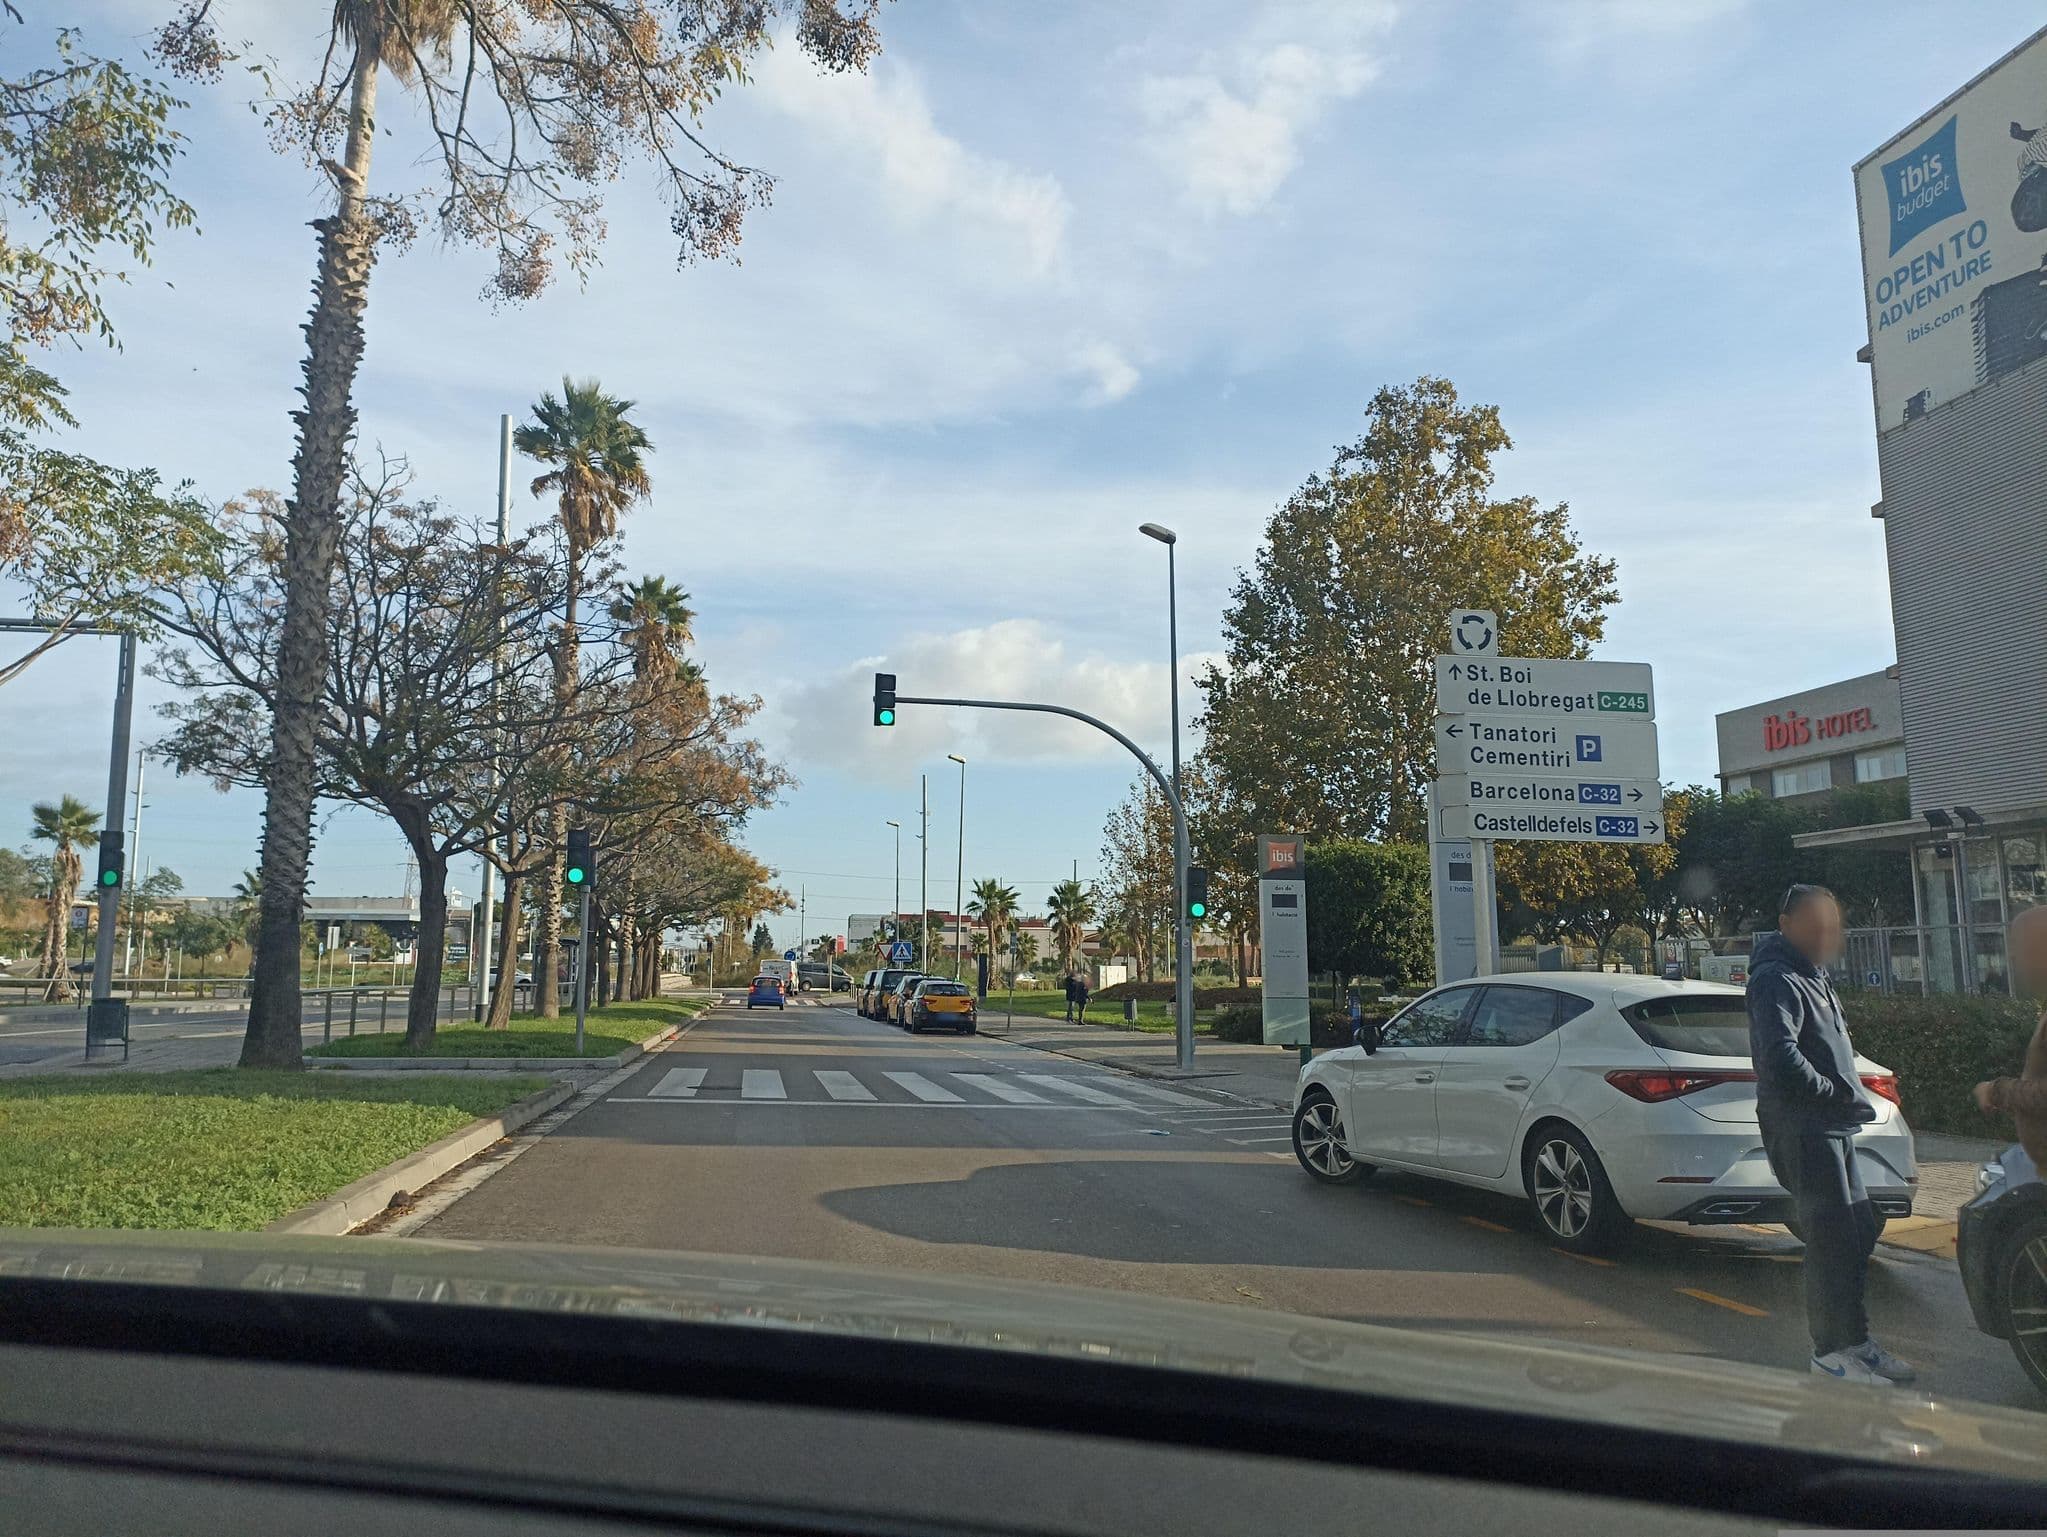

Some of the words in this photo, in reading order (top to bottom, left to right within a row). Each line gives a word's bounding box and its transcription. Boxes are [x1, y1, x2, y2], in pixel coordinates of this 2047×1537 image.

[1899, 152, 1943, 198] ibis
[1896, 174, 1950, 222] budget
[1875, 243, 1946, 305] OPEN
[1948, 218, 1988, 265] TO
[1878, 249, 1993, 331] ADVENTURE
[1906, 302, 1965, 344] ibis.com
[1466, 664, 1494, 682] St.
[1500, 665, 1532, 684] Boi
[1468, 688, 1492, 705] de
[1497, 689, 1595, 712] Llobregat
[1601, 695, 1646, 710] C-245
[1469, 723, 1557, 744] Tanatori
[1762, 710, 1810, 752] ibis
[1816, 706, 1878, 741] HOTEL
[1470, 746, 1571, 768] Cementiri
[1581, 739, 1597, 759] P
[1470, 781, 1575, 802] Barcelona
[1581, 787, 1619, 802] C-32
[1473, 813, 1593, 834] Castelldefels
[1598, 819, 1636, 835] C-32
[1271, 849, 1295, 863] ibis
